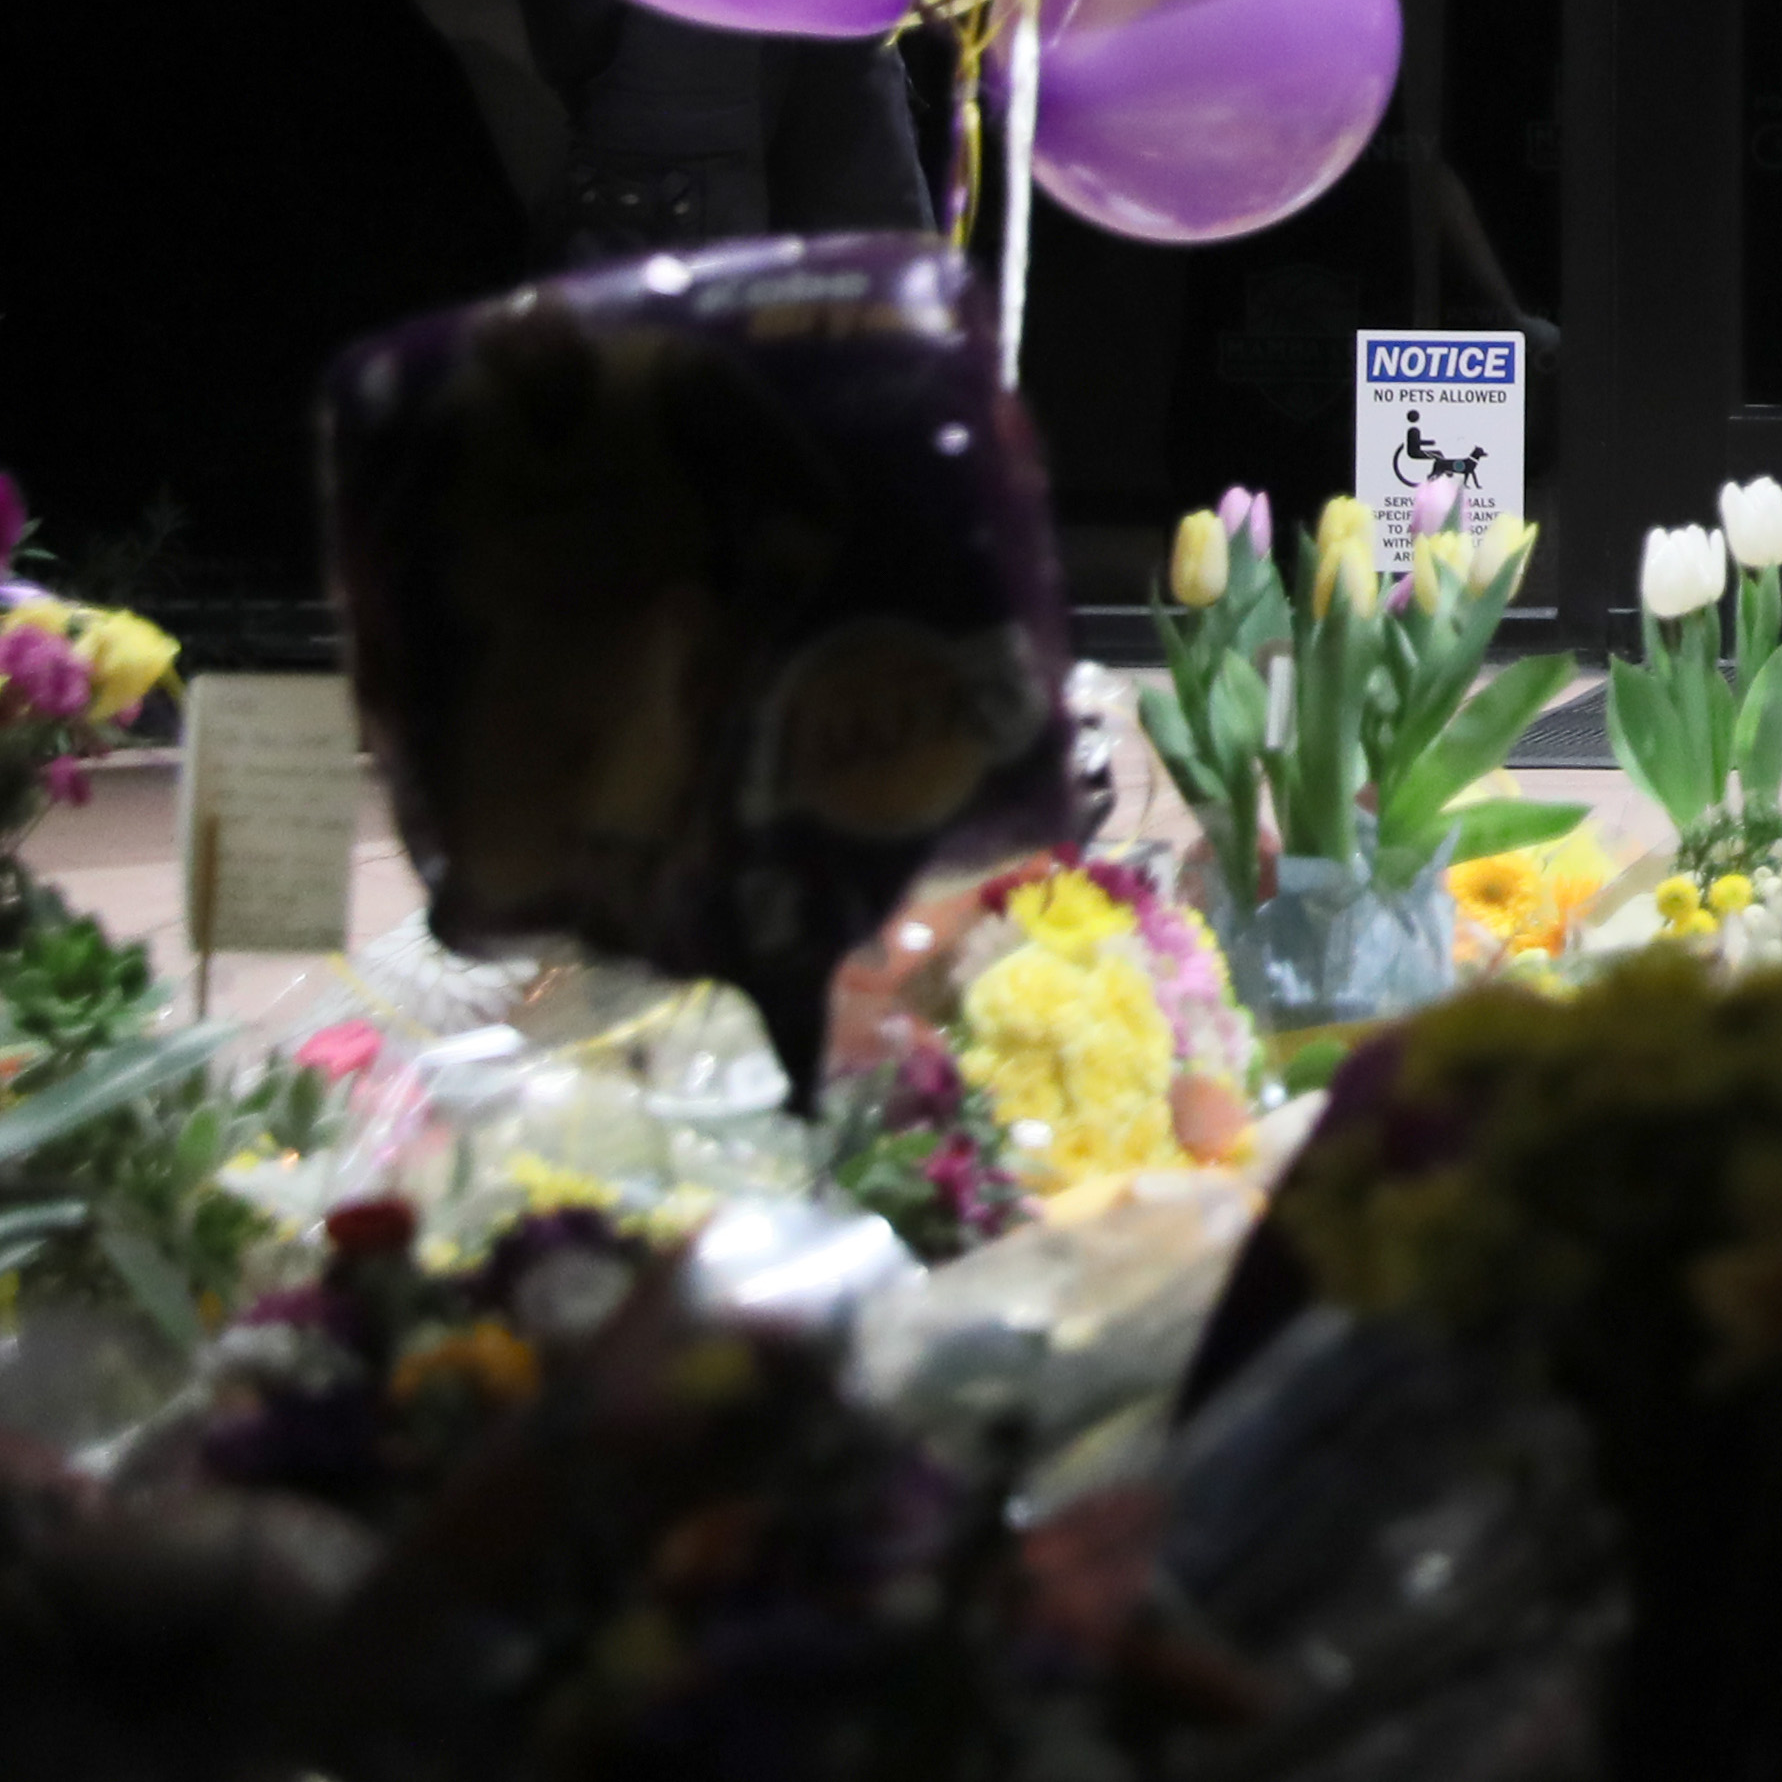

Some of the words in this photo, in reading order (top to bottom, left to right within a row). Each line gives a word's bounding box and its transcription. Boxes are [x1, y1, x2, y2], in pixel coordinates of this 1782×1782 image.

[1372, 346, 1510, 379] NOTICE
[1374, 389, 1394, 403] NO
[1399, 389, 1435, 403] PETS
[1439, 390, 1507, 404] ALLOWED
[1388, 524, 1403, 534] TO
